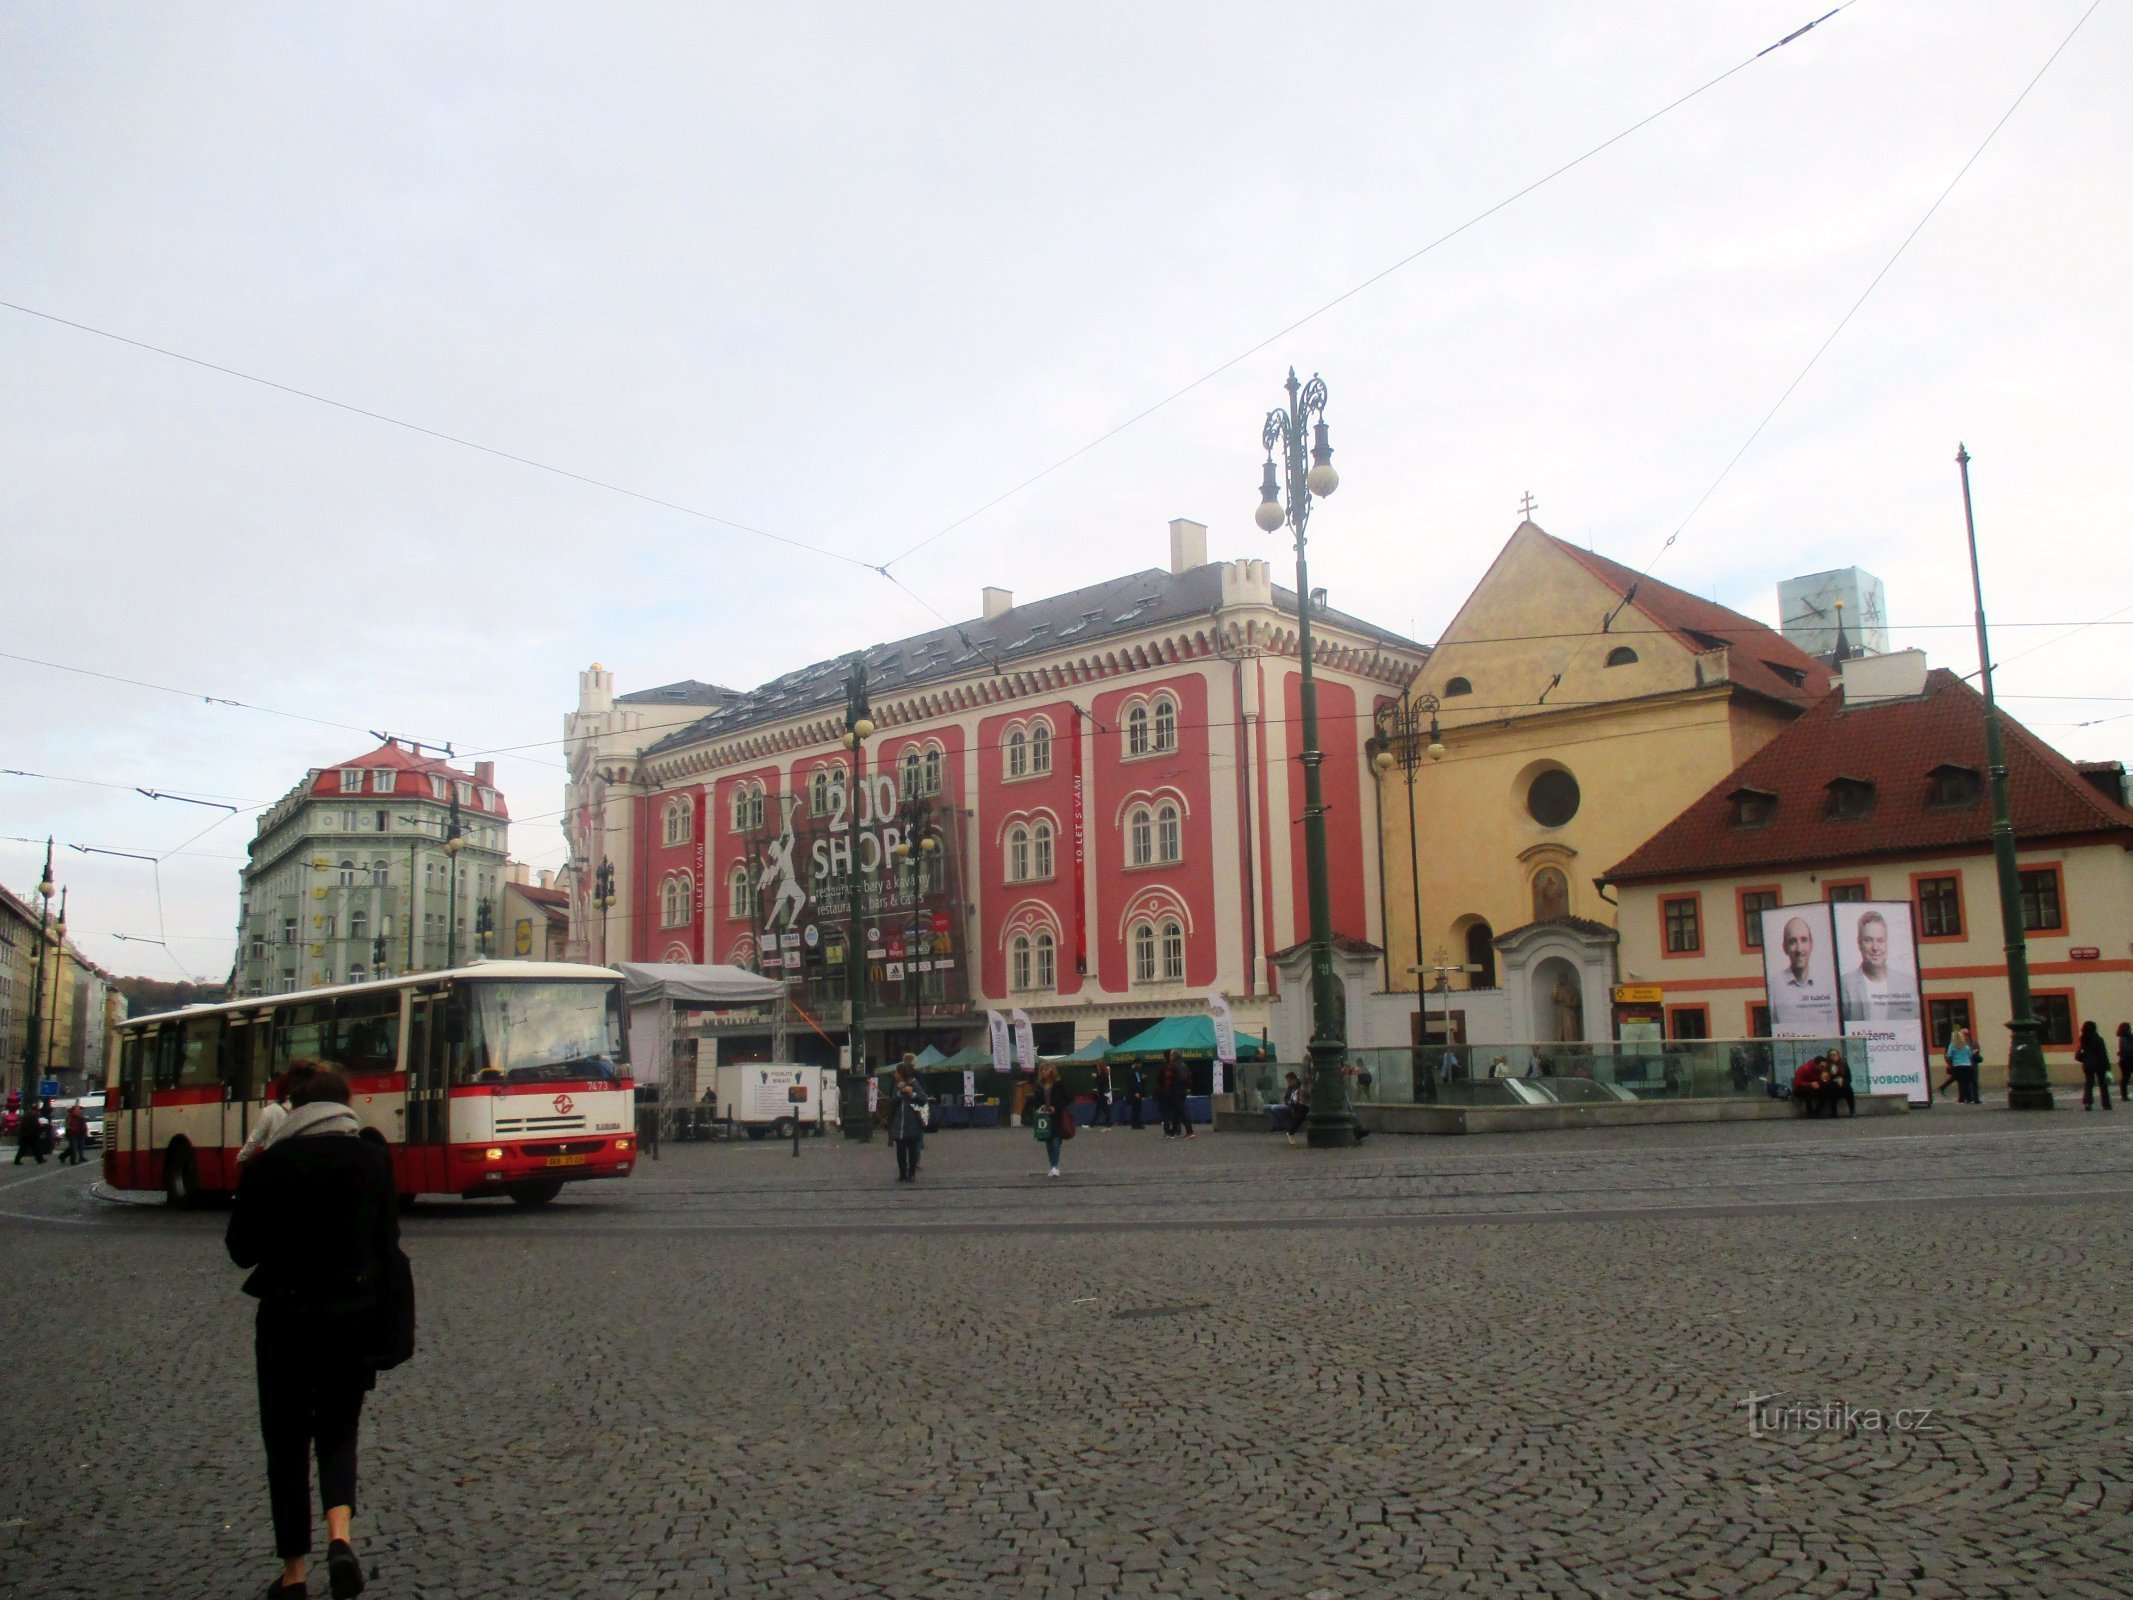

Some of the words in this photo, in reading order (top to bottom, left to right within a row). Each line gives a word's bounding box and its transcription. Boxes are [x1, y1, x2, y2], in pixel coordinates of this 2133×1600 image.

[828, 775, 897, 832] 200
[1075, 823, 1083, 845] LET
[1075, 849, 1083, 864] 10
[893, 873, 930, 890] kavány
[695, 882, 704, 898] LET
[587, 1081, 608, 1091] 7473
